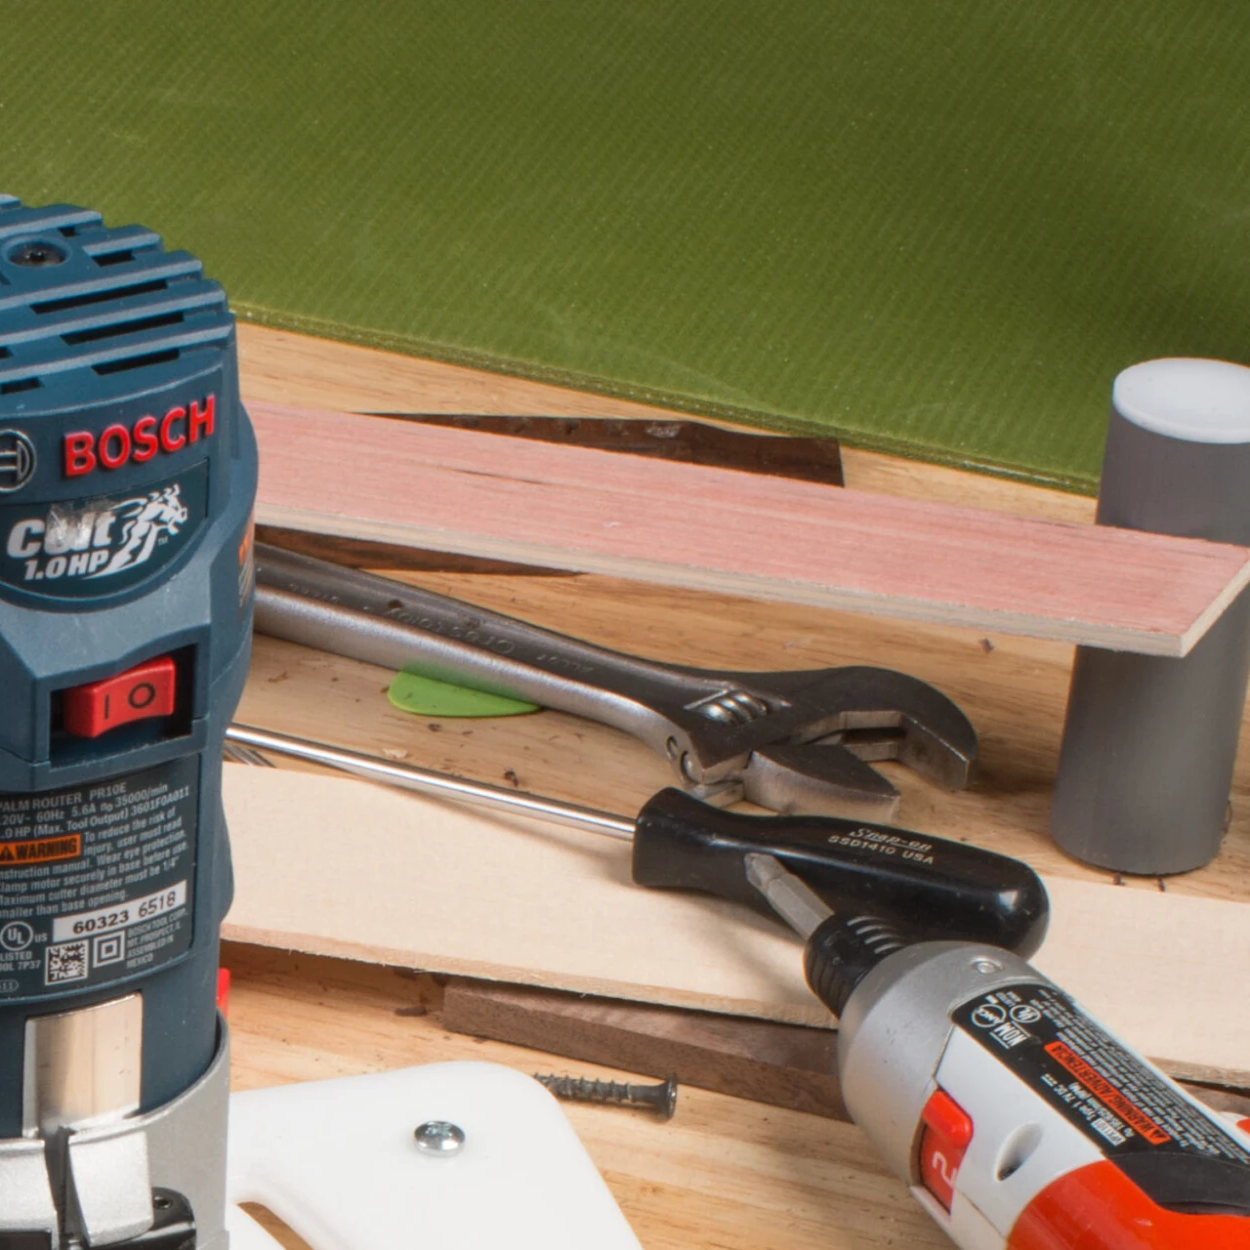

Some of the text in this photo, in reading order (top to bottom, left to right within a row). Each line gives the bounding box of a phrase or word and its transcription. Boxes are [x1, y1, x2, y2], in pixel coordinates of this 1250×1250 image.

[64, 394, 216, 477] BOSCH
[32, 792, 83, 809] ROUTER
[89, 782, 127, 799] PR10E
[16, 826, 32, 838] HP
[33, 821, 64, 838] (Max.
[67, 817, 89, 831] Tool
[90, 808, 129, 828] Output)
[36, 811, 65, 824] 60Hz
[71, 803, 97, 818] 5.6A
[84, 805, 177, 843] To reduce the risk of
[116, 834, 138, 849] user
[139, 826, 162, 843] must
[163, 816, 183, 833] read
[848, 826, 933, 853] Snap-on
[16, 838, 78, 860] WARNING
[52, 858, 93, 875] manual.
[95, 851, 122, 867] Wear
[123, 847, 140, 862] eye
[901, 850, 935, 865] USA
[30, 877, 61, 891] motor
[63, 868, 106, 888] securely
[107, 866, 117, 877] in
[118, 857, 141, 873] base
[142, 847, 171, 868] before
[48, 887, 78, 900] cutter
[79, 877, 123, 897] diameter
[124, 871, 148, 888] must
[36, 902, 59, 915] than
[60, 898, 85, 913] base
[72, 890, 177, 935] 60323 6518
[0, 951, 33, 962] LISTED
[993, 1021, 1031, 1048] NOM
[1050, 1044, 1153, 1133] WARNING/ADVERTENCIA
[931, 1150, 959, 1189] 2
